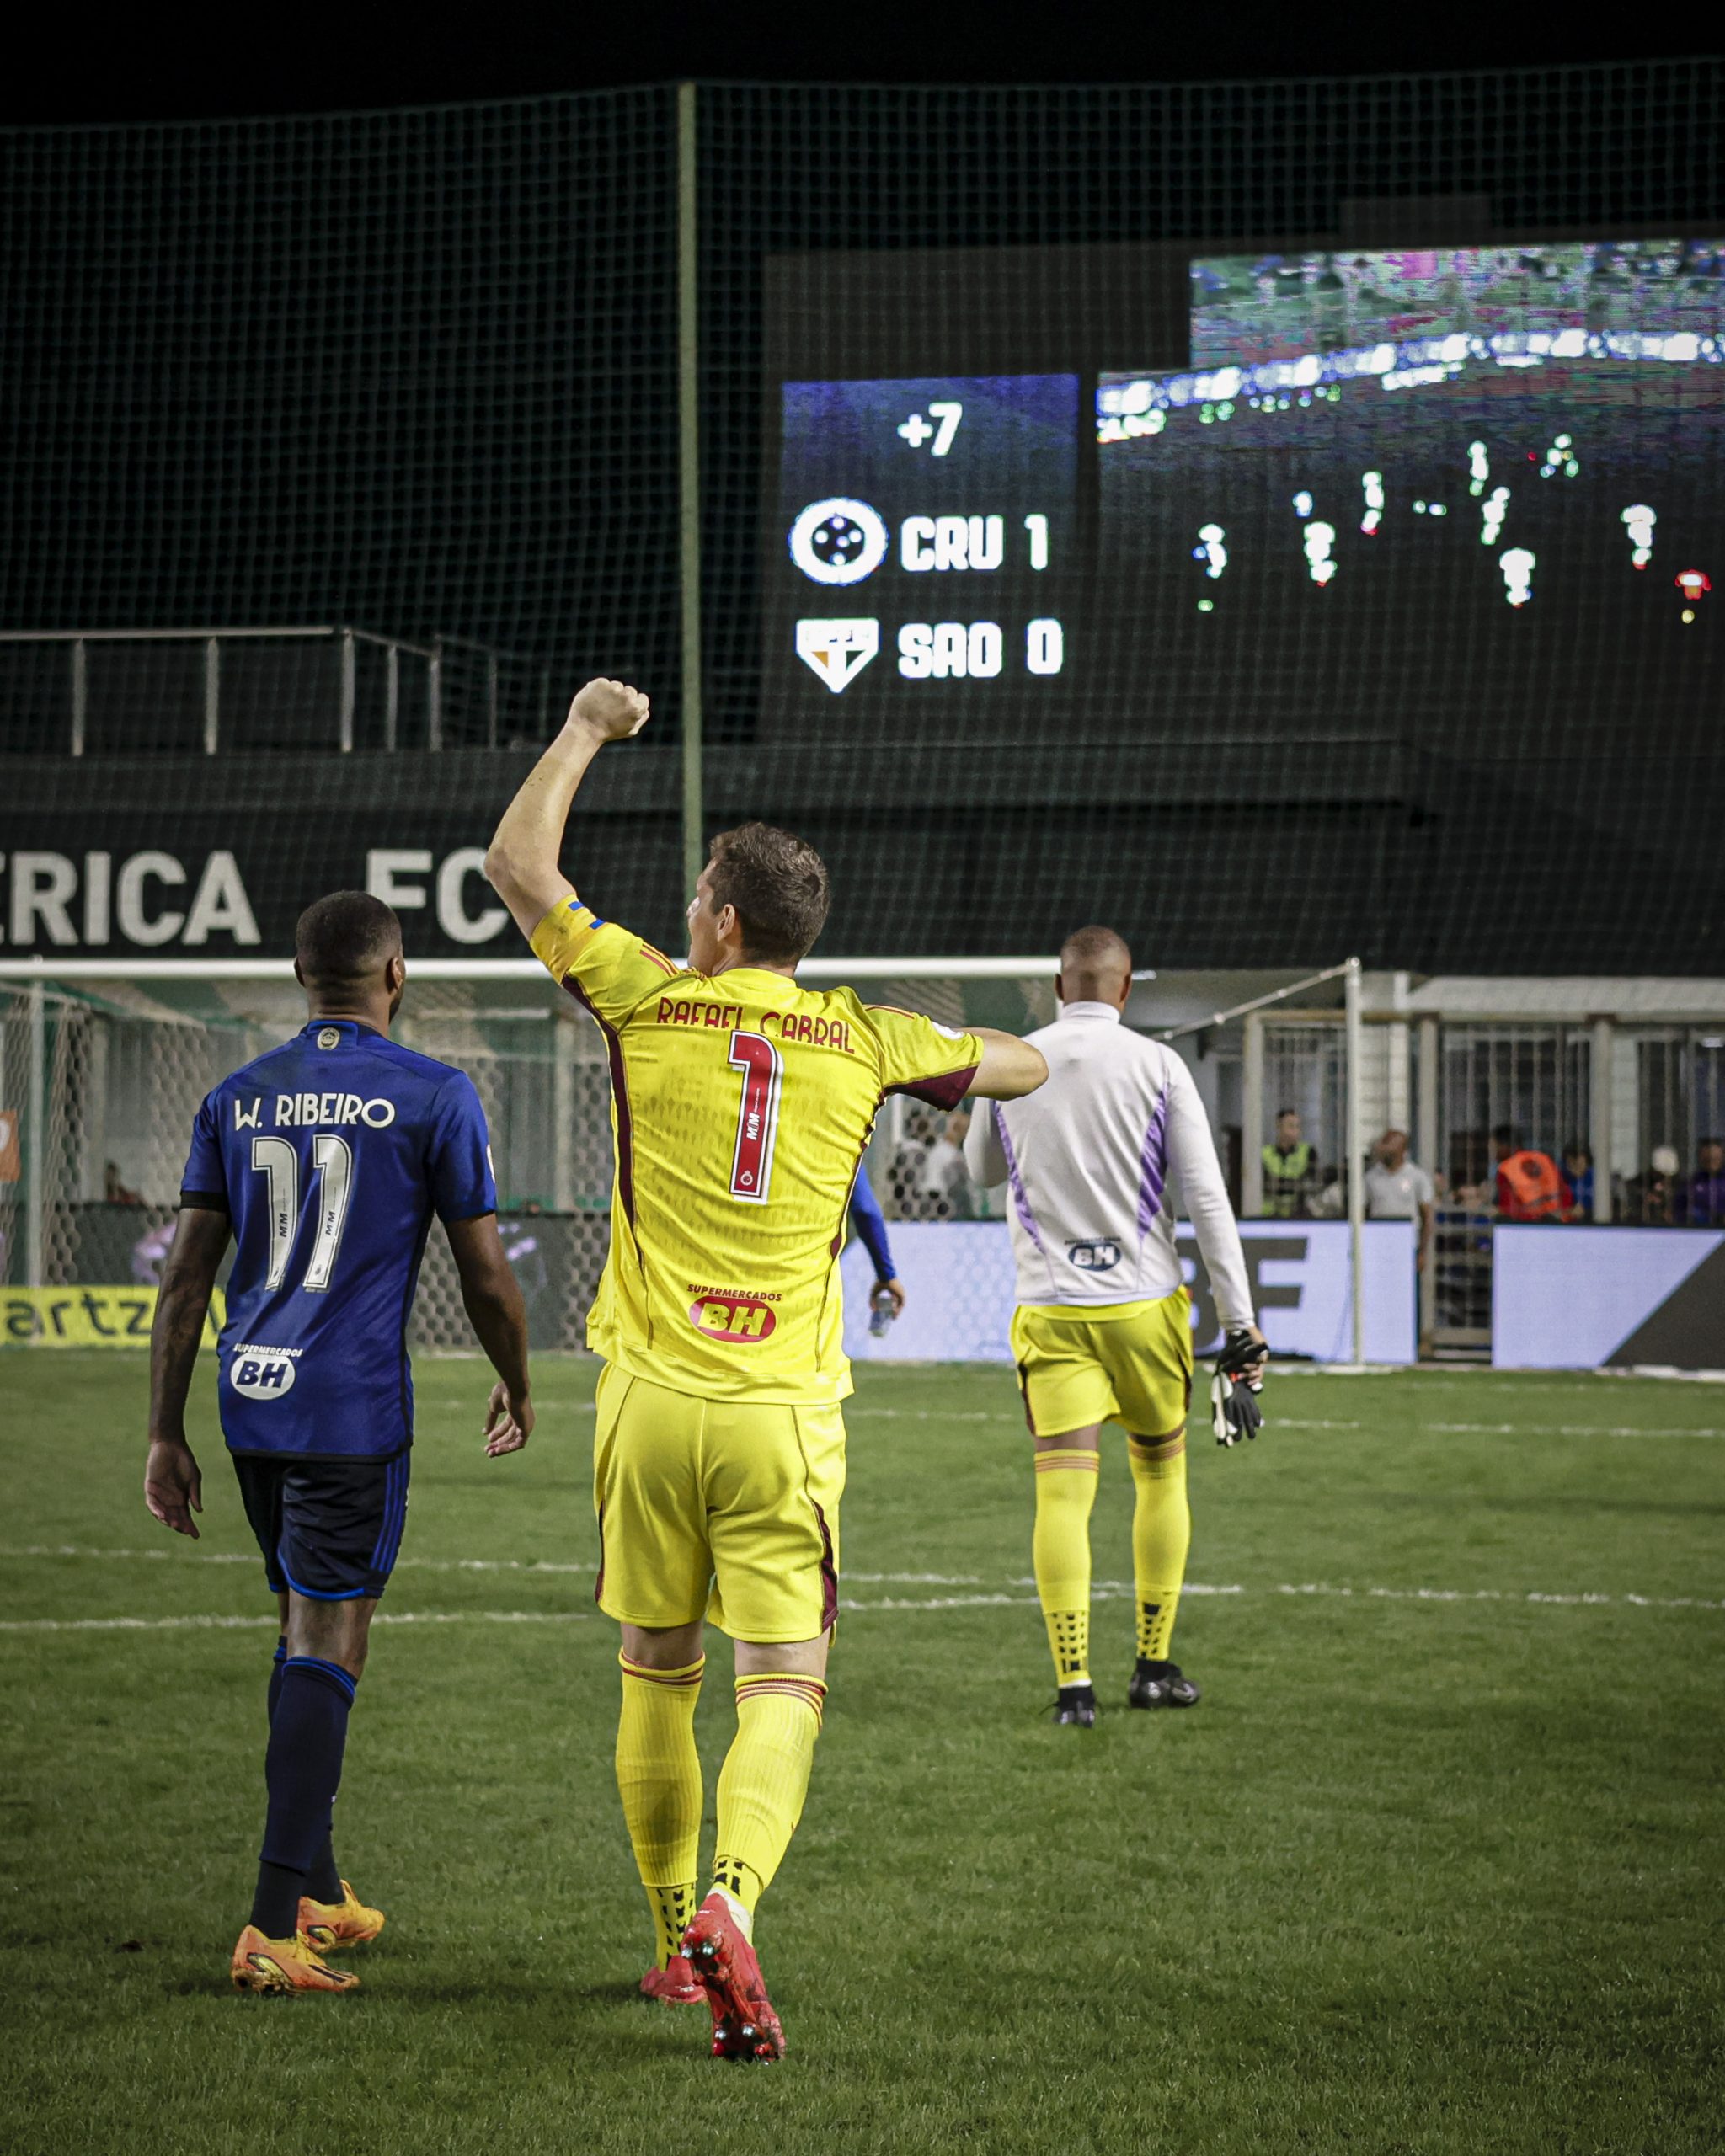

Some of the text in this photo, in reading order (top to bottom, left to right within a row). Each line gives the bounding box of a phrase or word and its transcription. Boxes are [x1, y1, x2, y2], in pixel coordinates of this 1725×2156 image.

[898, 402, 963, 456] +7
[901, 514, 1048, 571] CRU 1
[898, 618, 1063, 678] SAO 0
[0, 847, 510, 946] RICA FC
[760, 1011, 855, 1054] CABRAL
[235, 1093, 395, 1131] W. RIBEIRO
[728, 1030, 784, 1203] 1
[252, 1134, 354, 1292] 11
[1072, 1246, 1116, 1267] BH
[5, 1290, 221, 1338] artz
[687, 1283, 782, 1302] SUPERMERCADOS
[697, 1302, 768, 1337] BH
[233, 1343, 303, 1357] SUPERMERCADOS
[236, 1360, 288, 1388] BH
